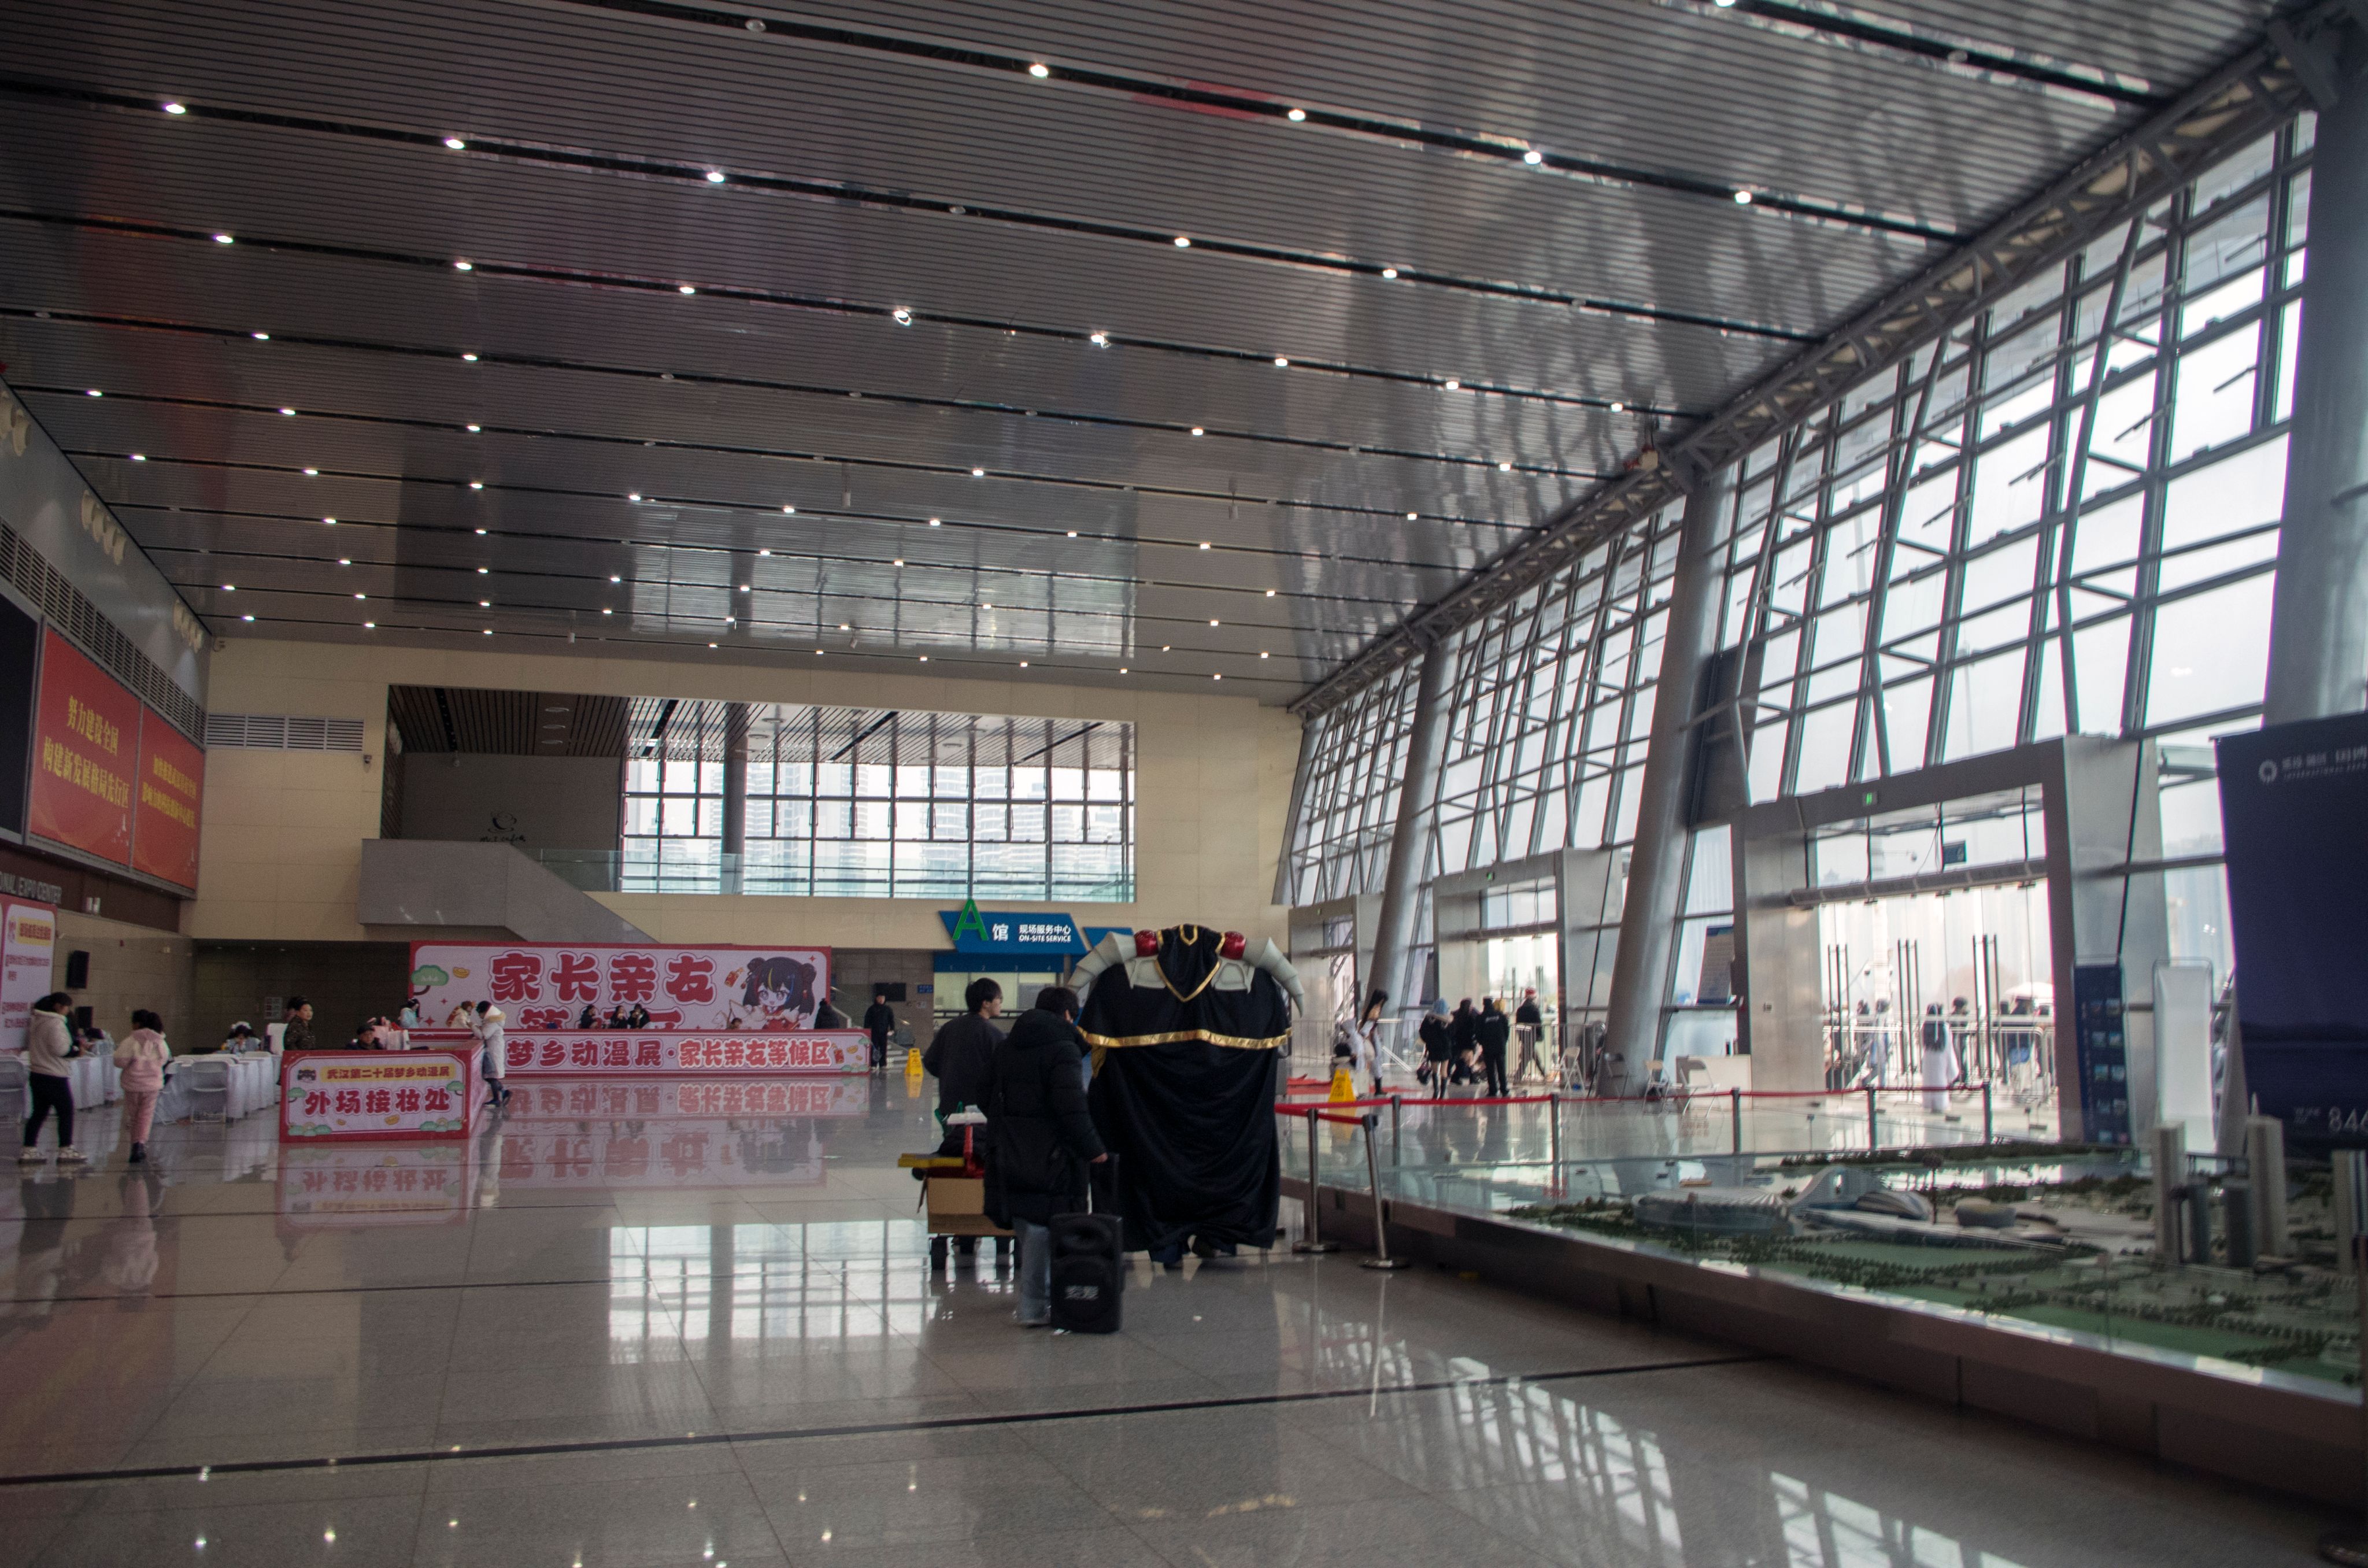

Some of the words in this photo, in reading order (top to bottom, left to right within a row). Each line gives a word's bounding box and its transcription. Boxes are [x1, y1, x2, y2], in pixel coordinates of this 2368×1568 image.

[67, 694, 119, 756] 努力建设全国
[43, 735, 130, 808] 构建新发展格局先行区
[953, 898, 989, 941] A
[993, 923, 1009, 941] 馆
[1019, 924, 1071, 935] 现场服务中心
[1046, 935, 1072, 943] SERVICE
[490, 952, 716, 1003] 家长亲友
[327, 1066, 450, 1079] 武汉第二十届梦乡动漫展
[305, 1087, 451, 1116] 外场接妆处
